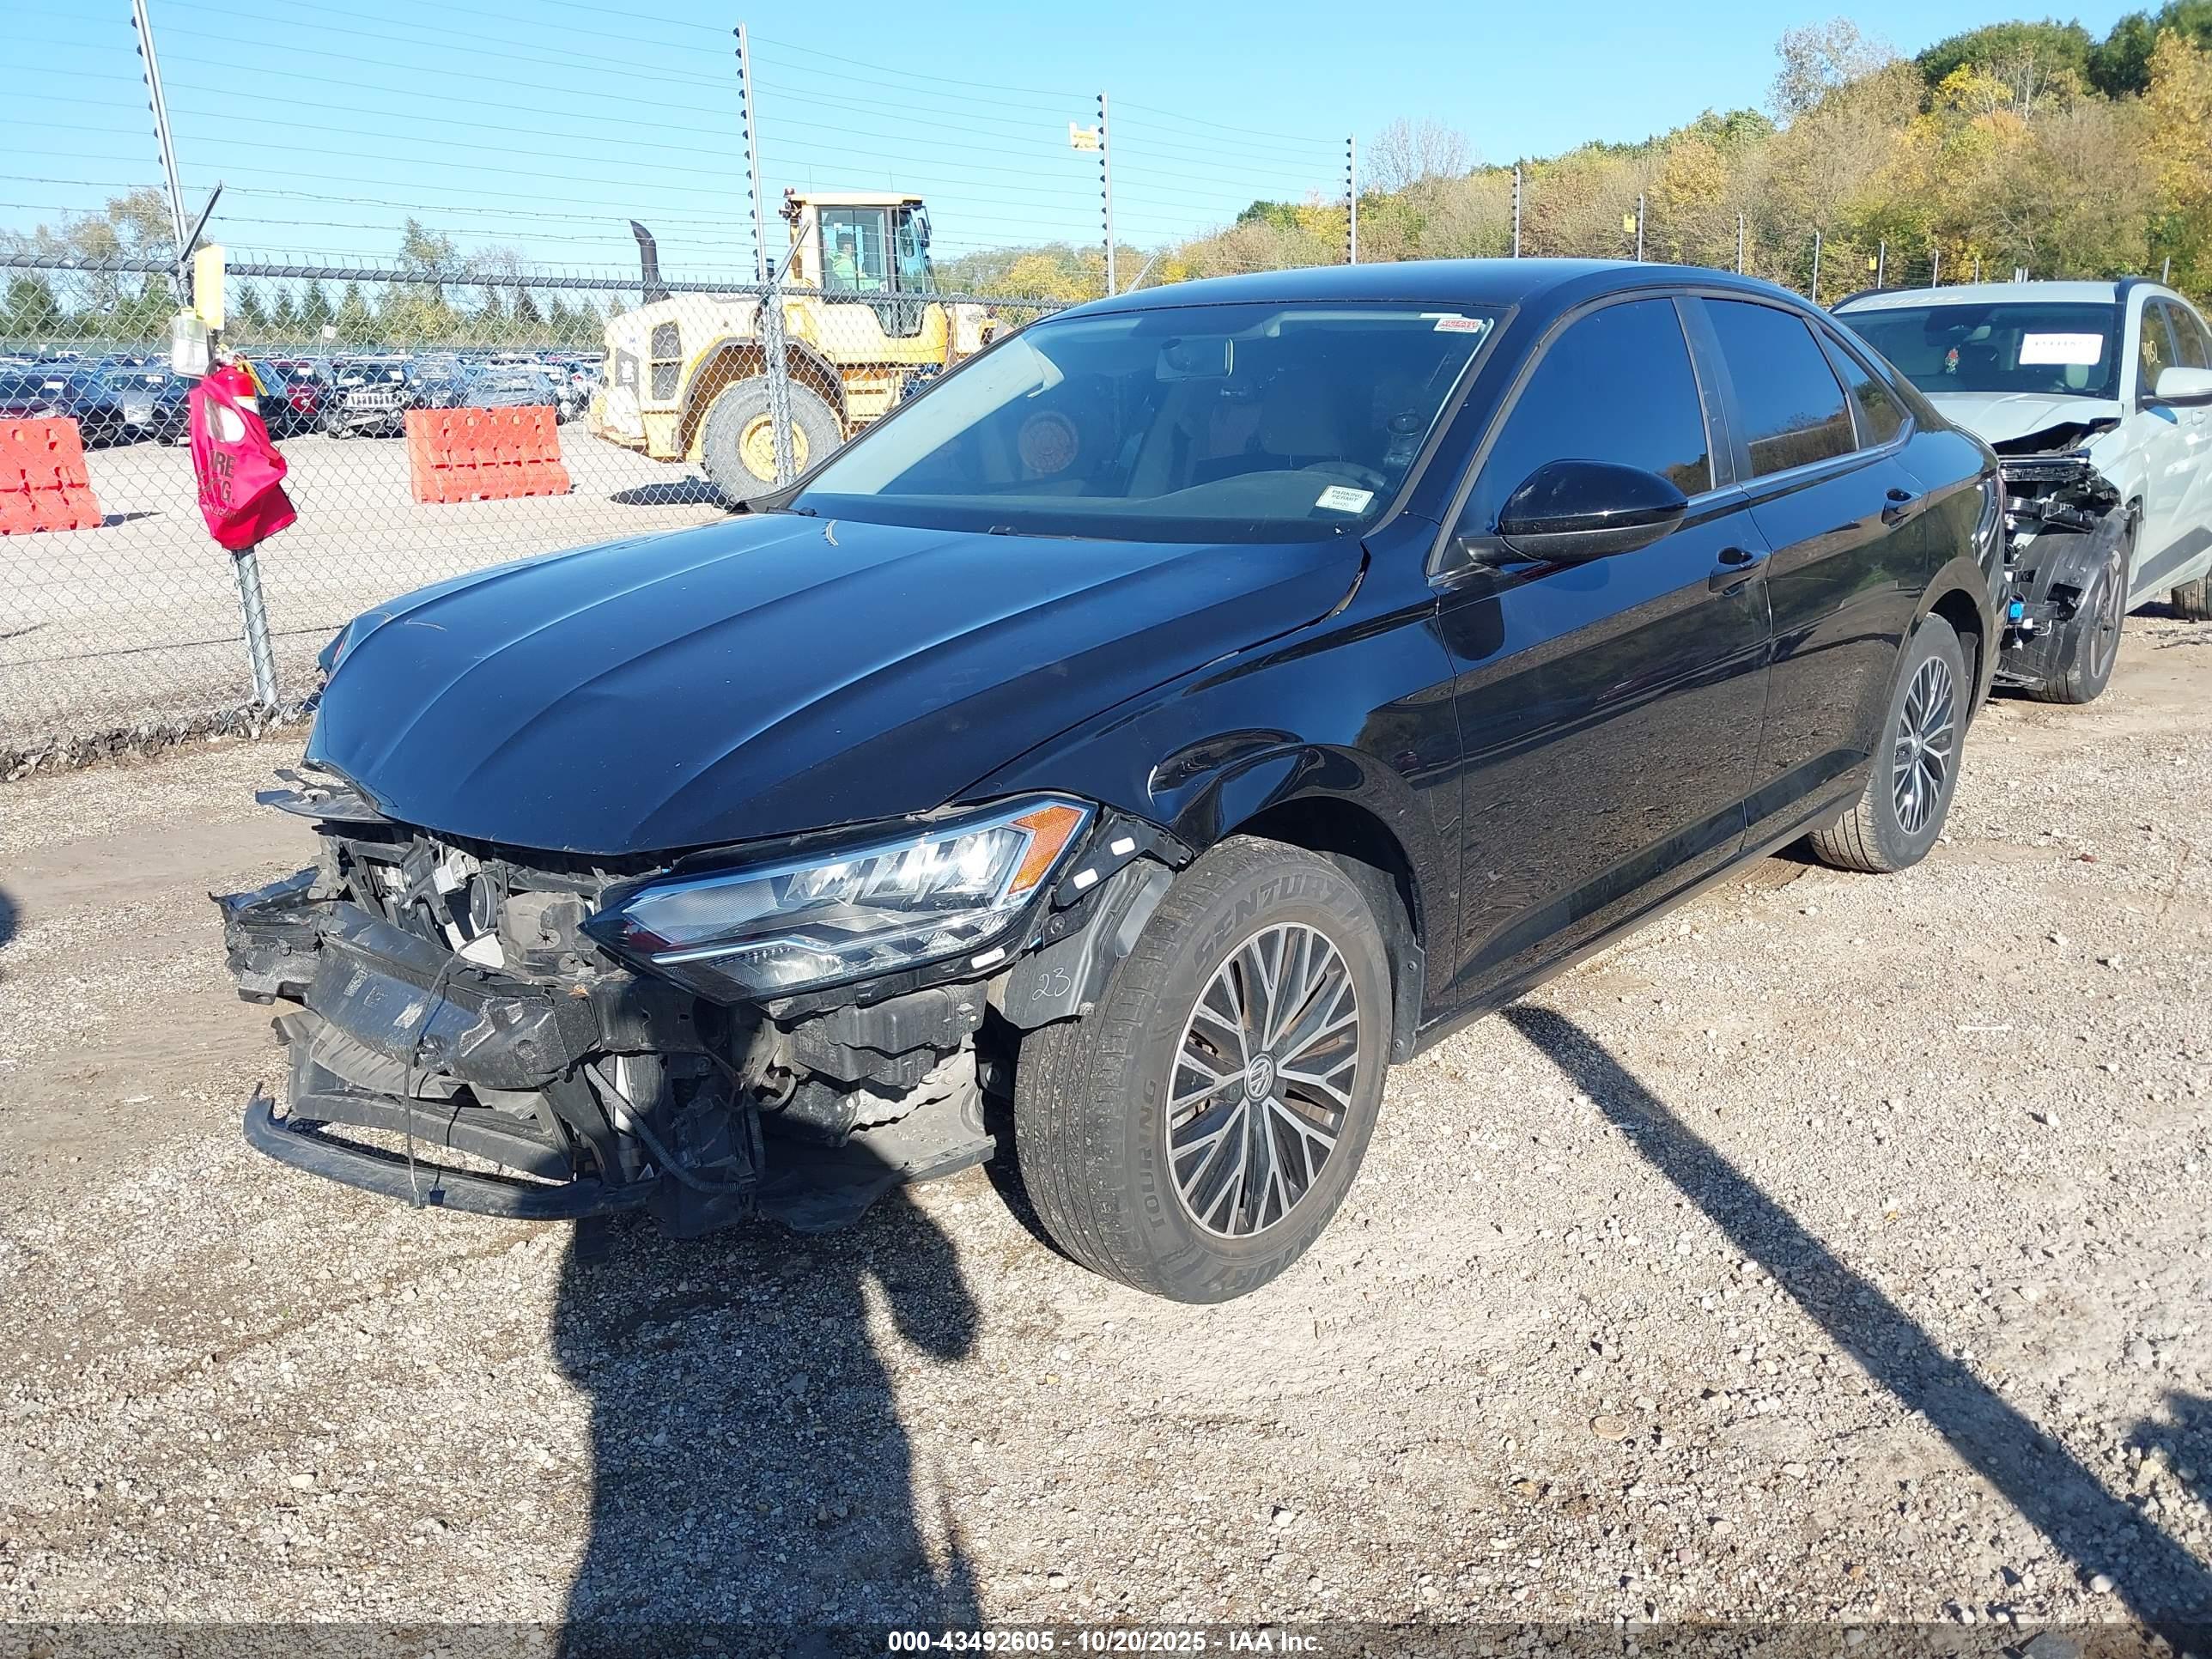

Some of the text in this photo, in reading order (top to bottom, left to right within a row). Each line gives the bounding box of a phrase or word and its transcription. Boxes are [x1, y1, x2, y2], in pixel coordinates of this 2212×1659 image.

[1332, 489, 1363, 498] PARKING
[1031, 967, 1072, 1001] 23
[1140, 1079, 1169, 1231] TOURING
